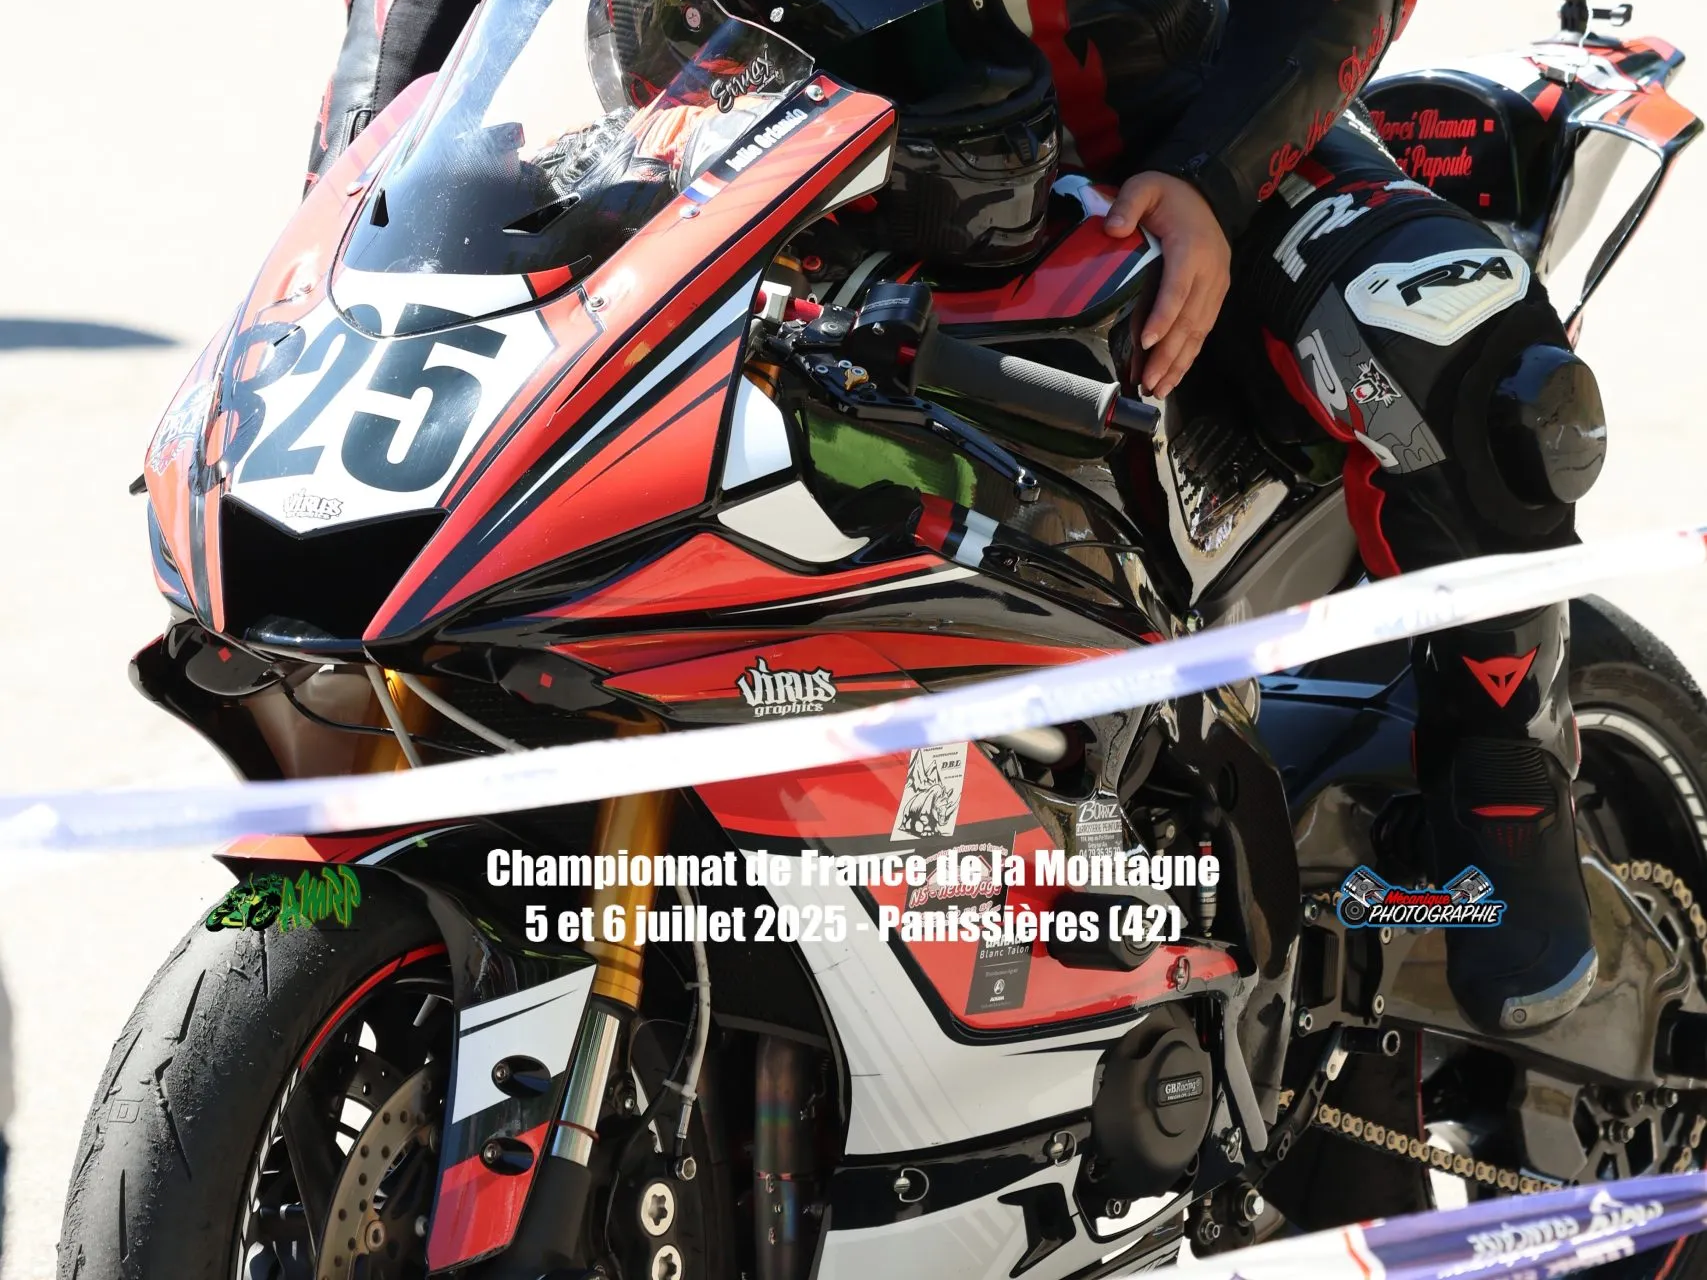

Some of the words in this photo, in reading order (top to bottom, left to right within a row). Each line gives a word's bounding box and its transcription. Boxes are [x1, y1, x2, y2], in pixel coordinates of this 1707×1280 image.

[753, 107, 809, 150] Orlando
[1417, 108, 1478, 140] Maman
[1396, 255, 1514, 307] RXA
[187, 302, 508, 497] 825
[753, 699, 824, 718] graphics
[979, 949, 1004, 960] Blanc
[1007, 945, 1030, 956] Talon
